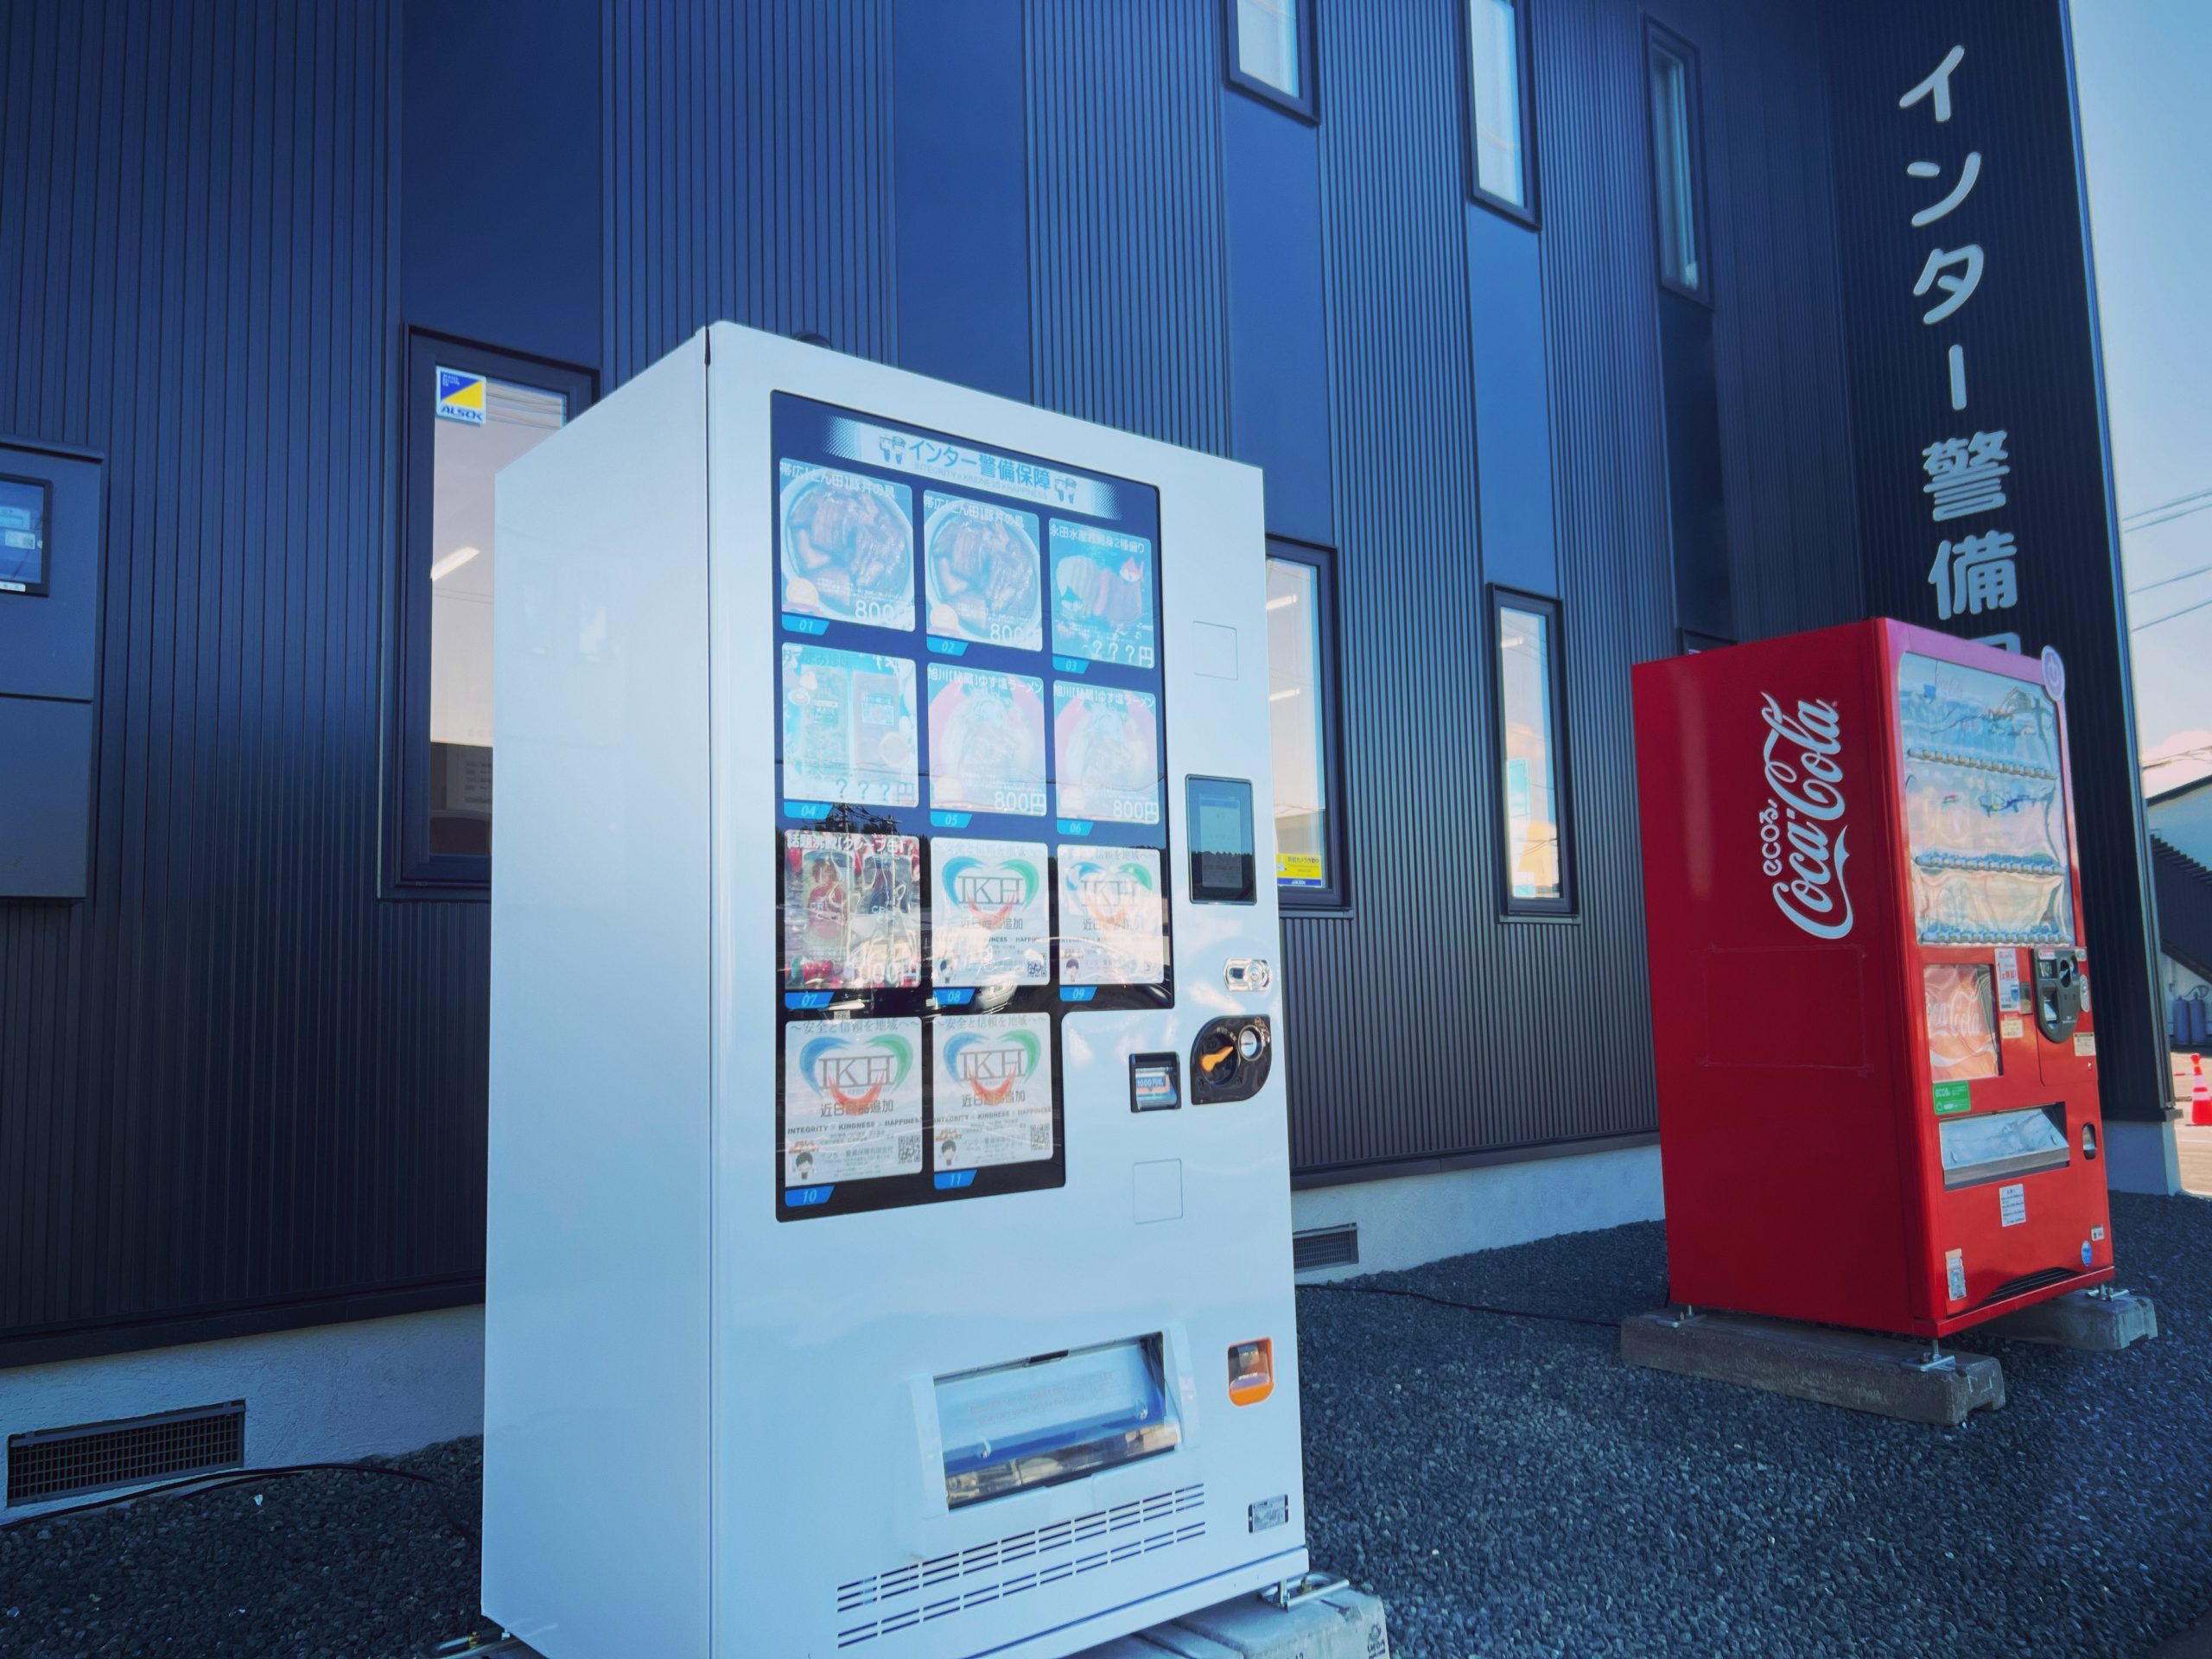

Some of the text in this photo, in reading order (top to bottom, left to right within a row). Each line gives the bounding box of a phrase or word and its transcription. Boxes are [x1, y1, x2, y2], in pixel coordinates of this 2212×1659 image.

[1899, 44, 2020, 655] インター警備
[442, 406, 482, 421] ALSOK
[908, 438, 1051, 491] インター警備保障
[798, 620, 814, 631] 01
[941, 641, 956, 652] 02
[1065, 659, 1077, 671] 03
[995, 791, 1046, 816] 800円
[801, 804, 816, 817] 04
[1113, 800, 1159, 823] 800円
[945, 815, 957, 826] 05
[1069, 822, 1082, 834] 06
[958, 876, 1024, 905] IKH
[947, 991, 962, 1003] 08
[1072, 988, 1085, 1000] 09
[802, 995, 817, 1007] 07
[959, 1049, 1026, 1081] IKH
[818, 1055, 895, 1090] IKH
[787, 1126, 829, 1135] INTEGRITY
[838, 1120, 875, 1131] KINDNESS
[950, 1175, 962, 1187] 11
[804, 1190, 817, 1203] 10
